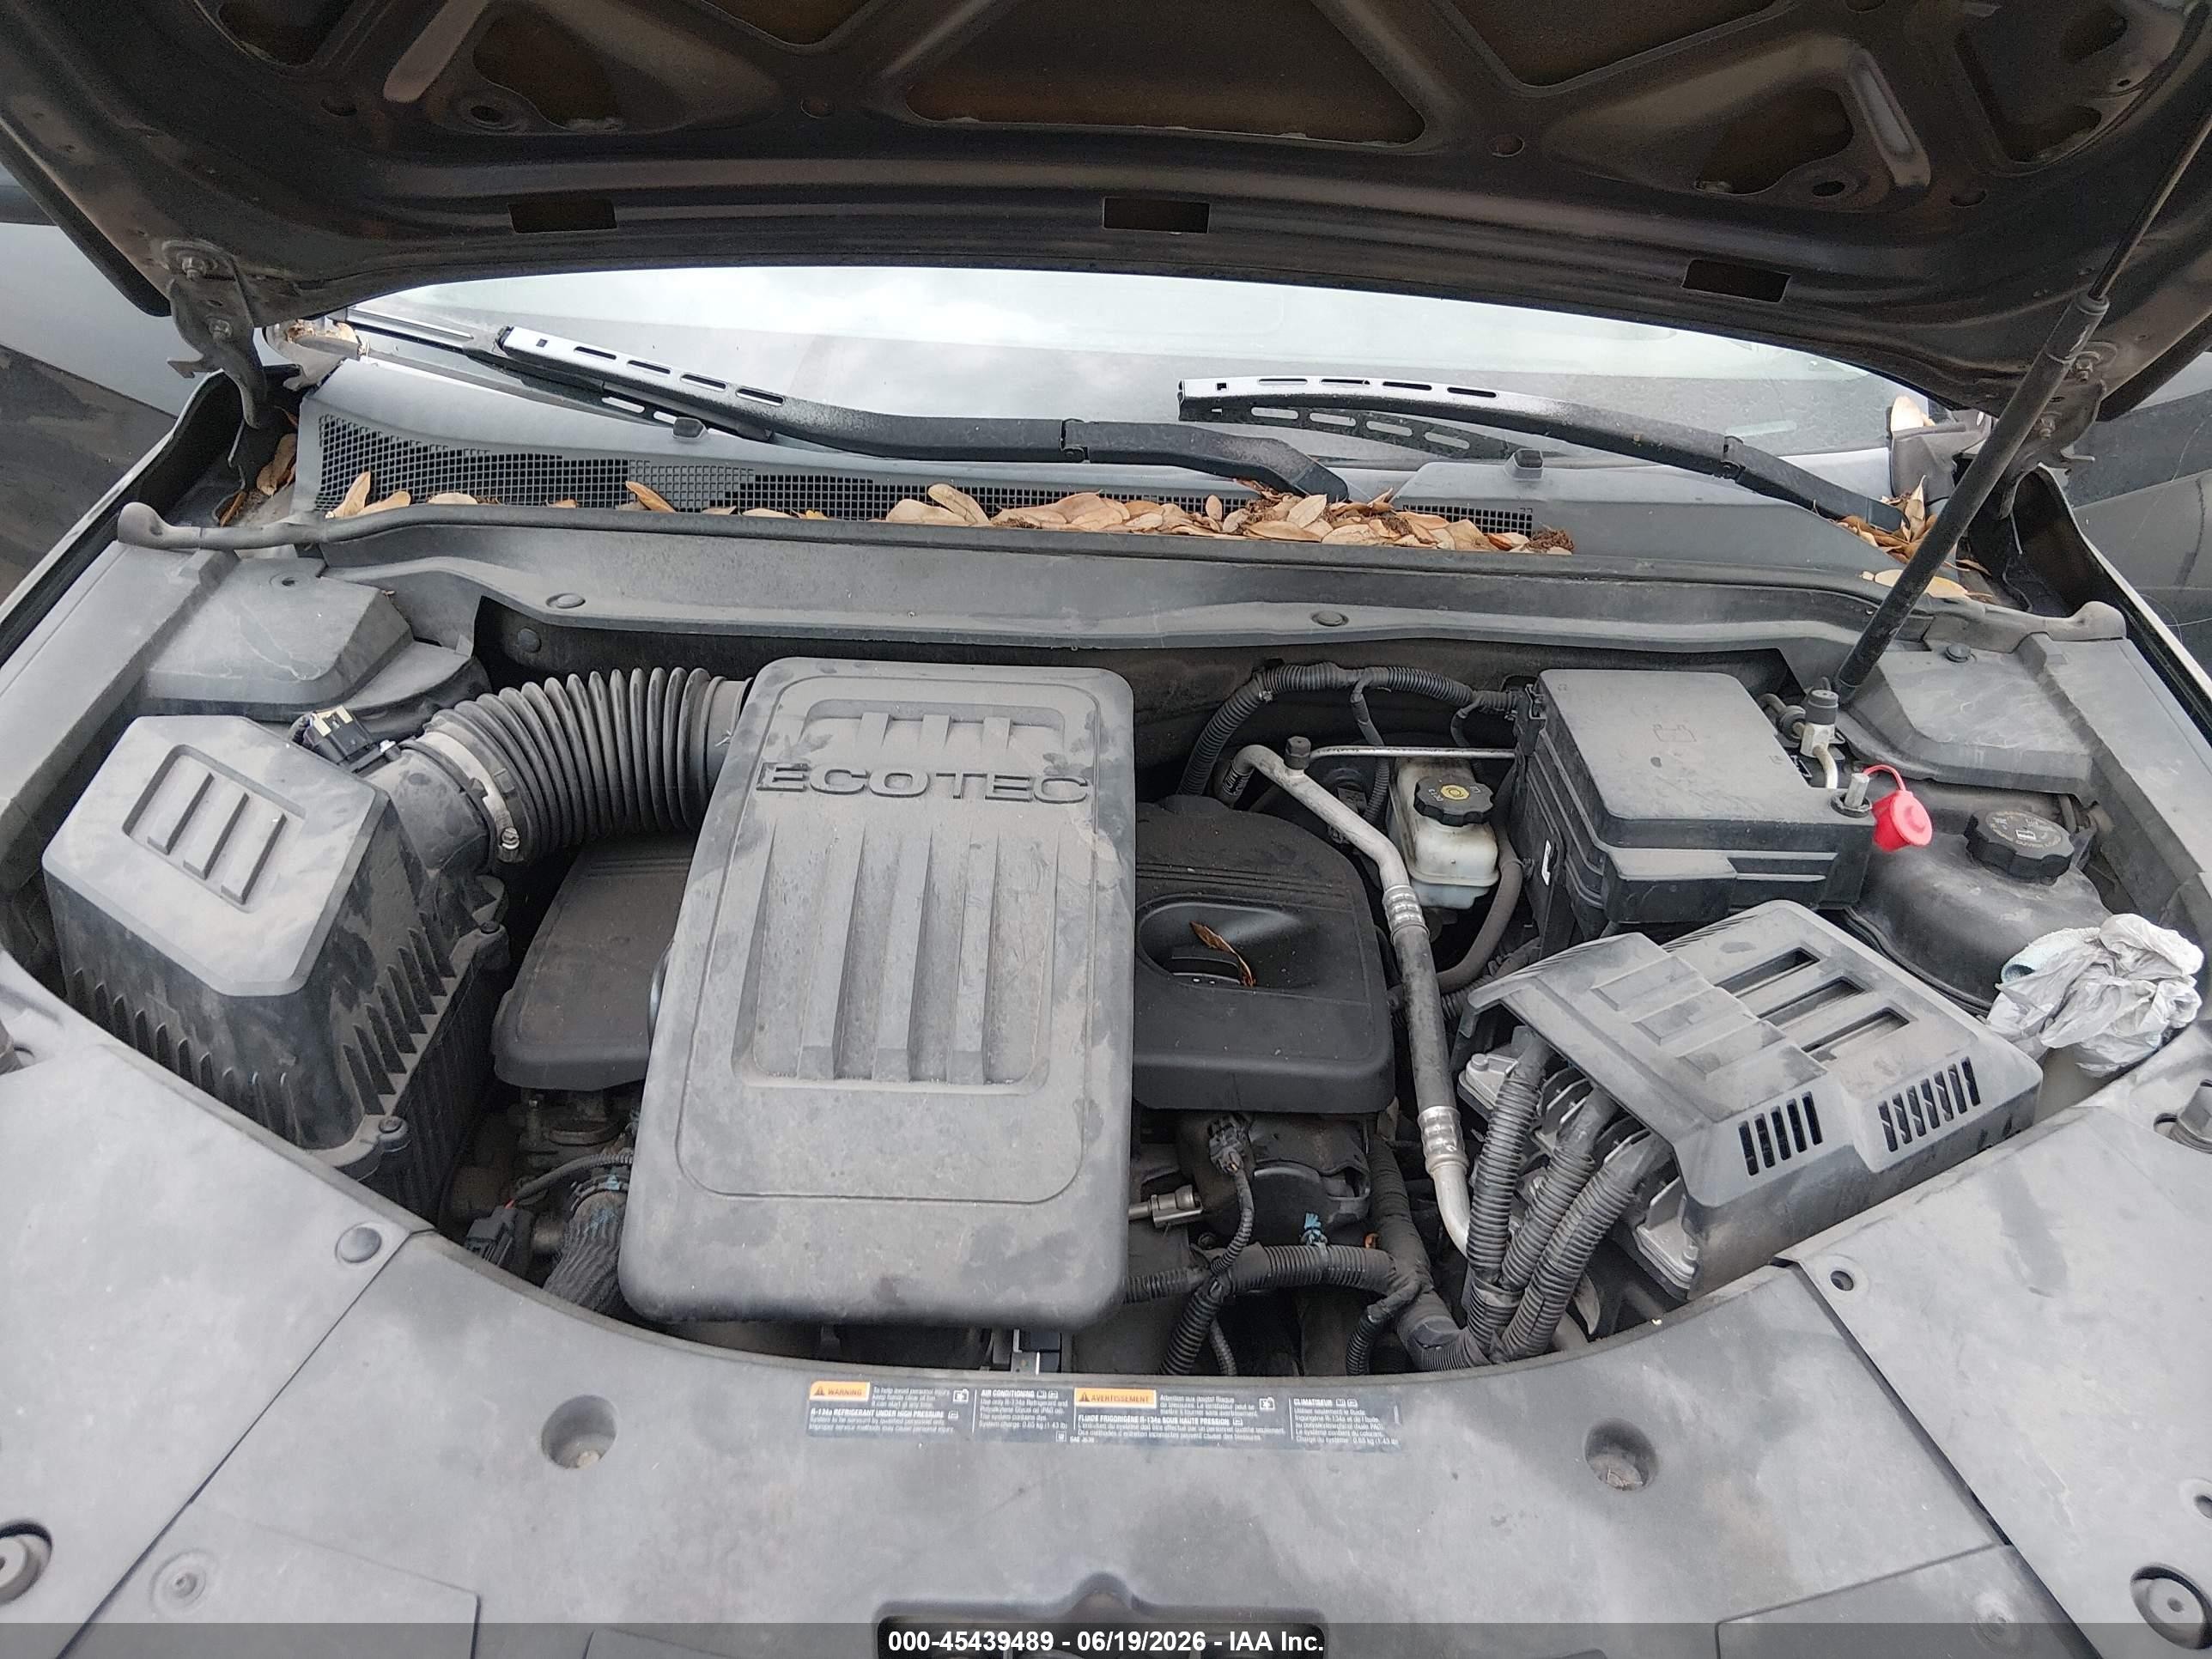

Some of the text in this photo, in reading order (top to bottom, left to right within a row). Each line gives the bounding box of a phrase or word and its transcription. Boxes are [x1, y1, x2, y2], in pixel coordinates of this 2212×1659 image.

[756, 762, 1089, 804] ECOTEC
[828, 1388, 861, 1396] WARNING
[1091, 1394, 1149, 1403] AVERTISSEMENT
